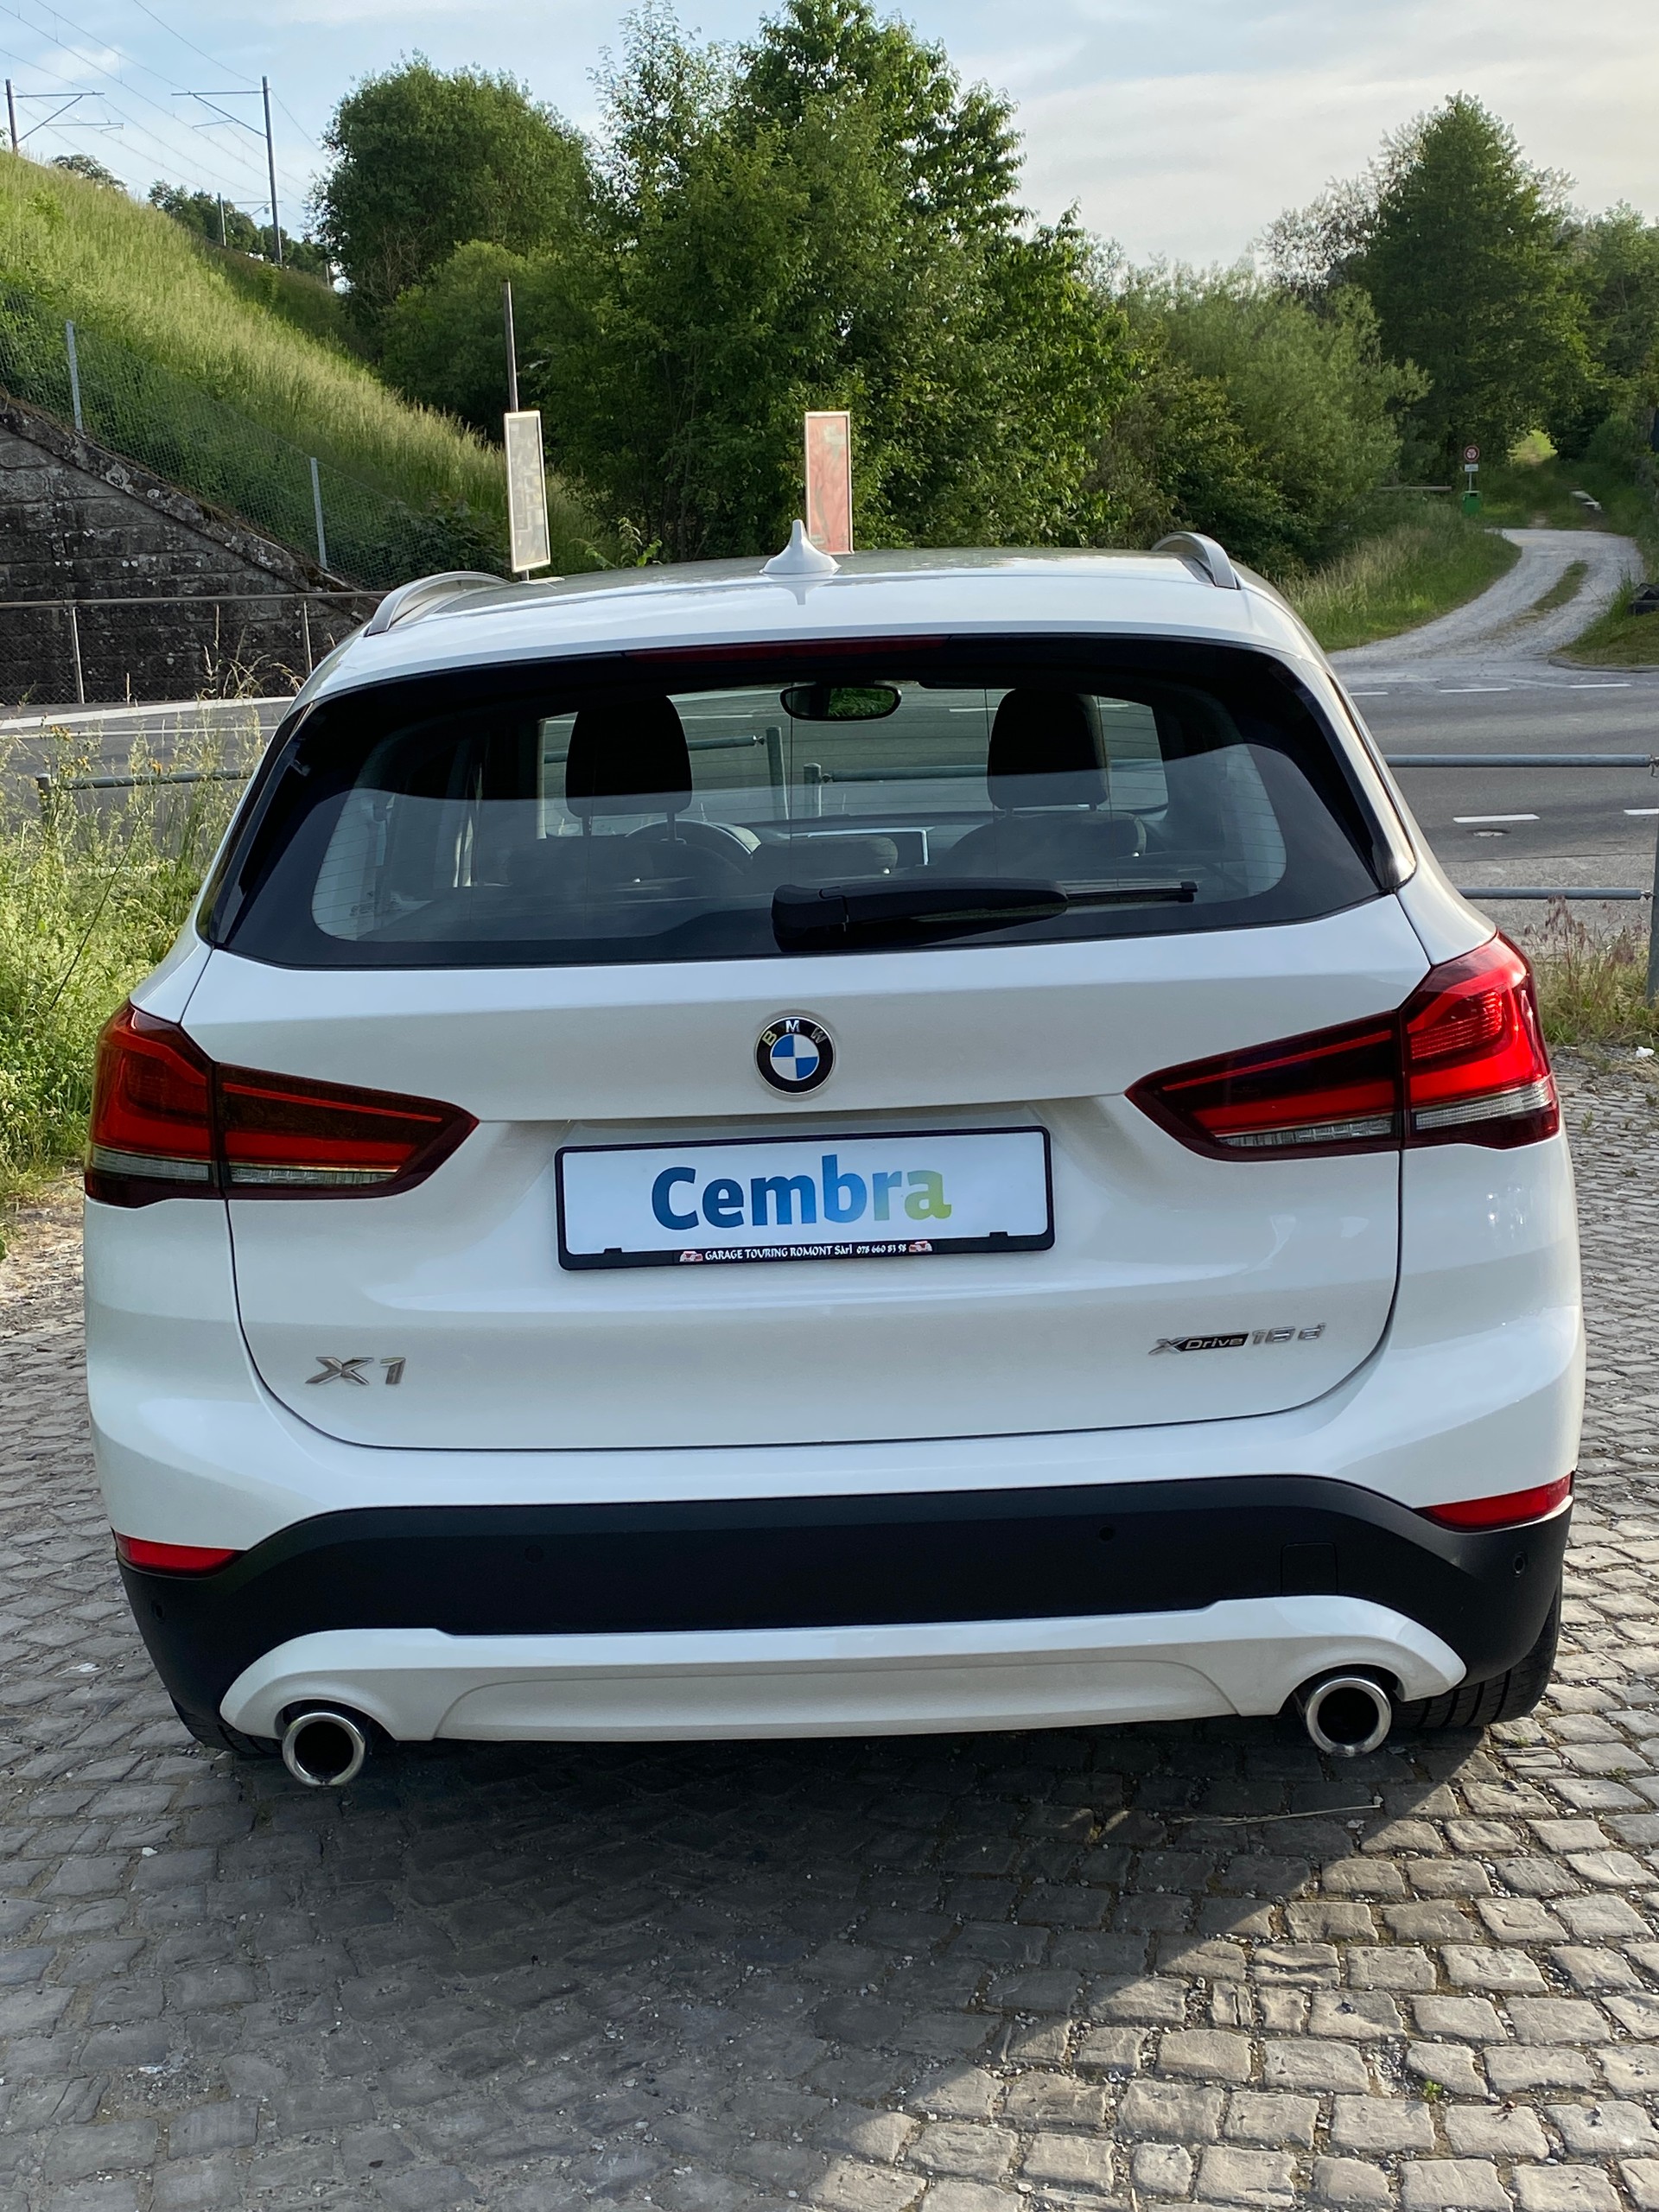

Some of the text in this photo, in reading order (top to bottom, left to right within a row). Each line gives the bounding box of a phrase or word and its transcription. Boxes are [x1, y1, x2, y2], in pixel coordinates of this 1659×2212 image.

[761, 1020, 827, 1046] BMW
[652, 1154, 951, 1230] Cembra
[705, 1249, 743, 1261] GARAGE
[745, 1247, 788, 1259] TOURING
[790, 1245, 832, 1257] ROMONT
[304, 1356, 407, 1386] X1
